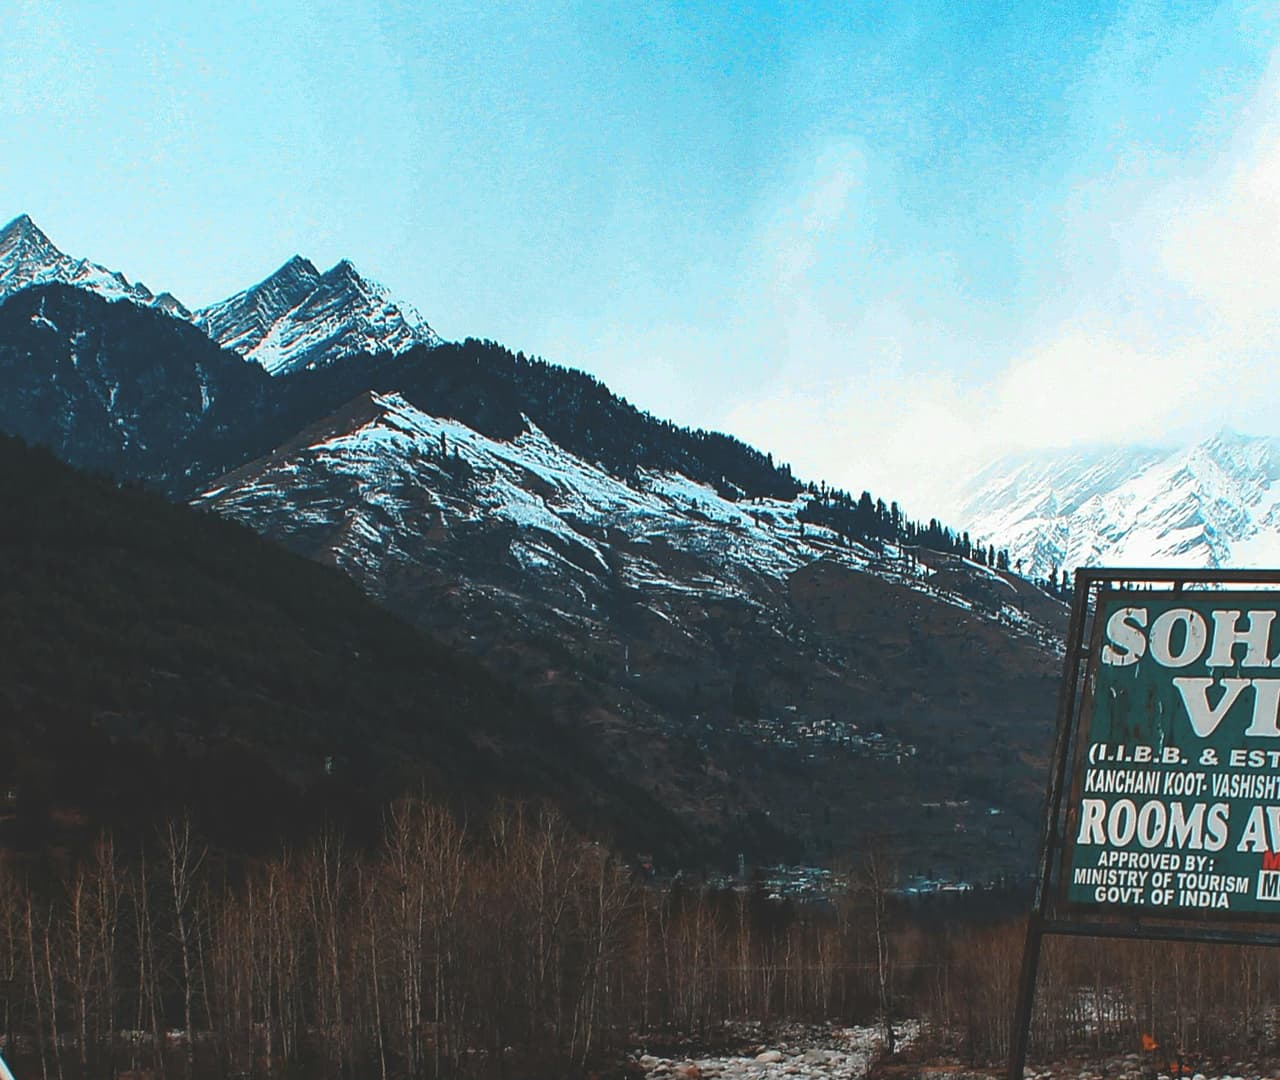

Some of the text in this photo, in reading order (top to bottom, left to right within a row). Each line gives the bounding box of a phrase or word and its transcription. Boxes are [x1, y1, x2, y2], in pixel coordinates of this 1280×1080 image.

[1199, 748, 1219, 766] &
[1084, 769, 1161, 795] KANCHANI
[1077, 798, 1230, 852] ROOMS
[1097, 851, 1215, 872] APPROVED BY:
[1074, 868, 1249, 894] MINISTRY OF TOURISM
[1094, 886, 1230, 909] GOVT. OF INDIA
